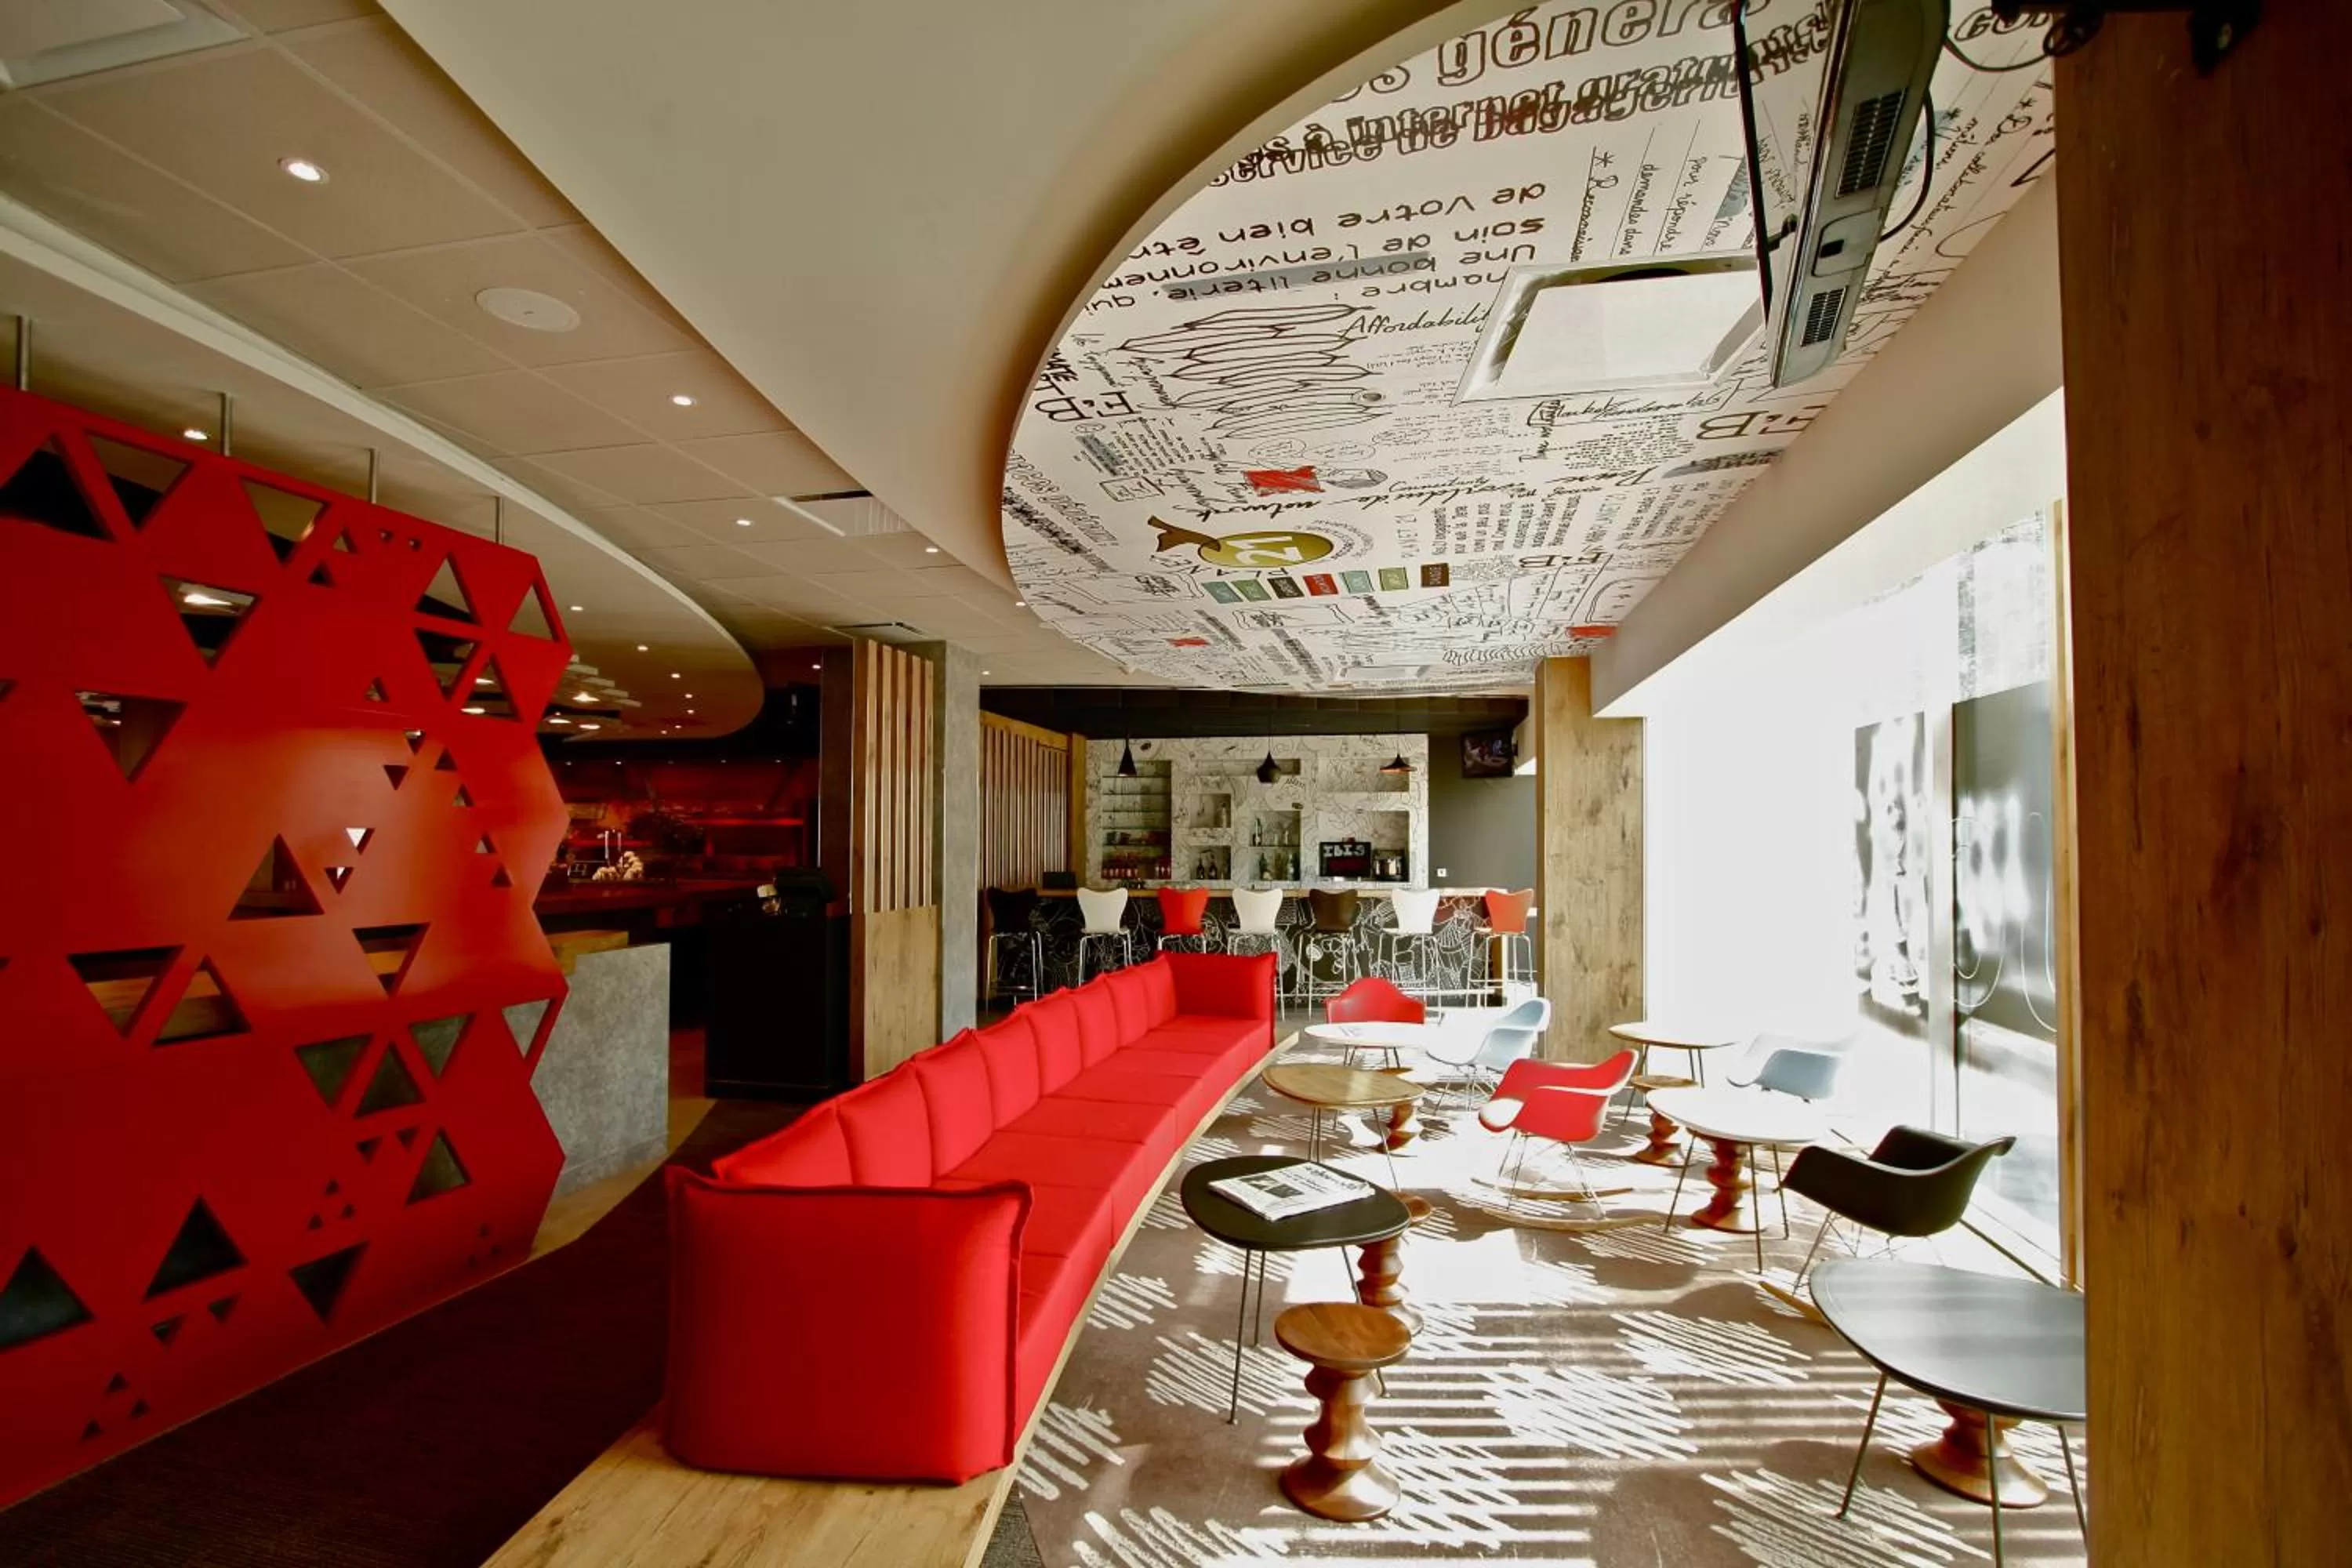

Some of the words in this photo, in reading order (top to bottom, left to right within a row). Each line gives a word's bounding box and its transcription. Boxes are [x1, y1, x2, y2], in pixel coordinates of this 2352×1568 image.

[1492, 182, 1546, 204] de
[1218, 218, 1315, 245] bien
[1381, 231, 1432, 252] de
[1453, 216, 1547, 243] soin
[1311, 252, 1437, 284] bonne
[1226, 535, 1303, 565] 21
